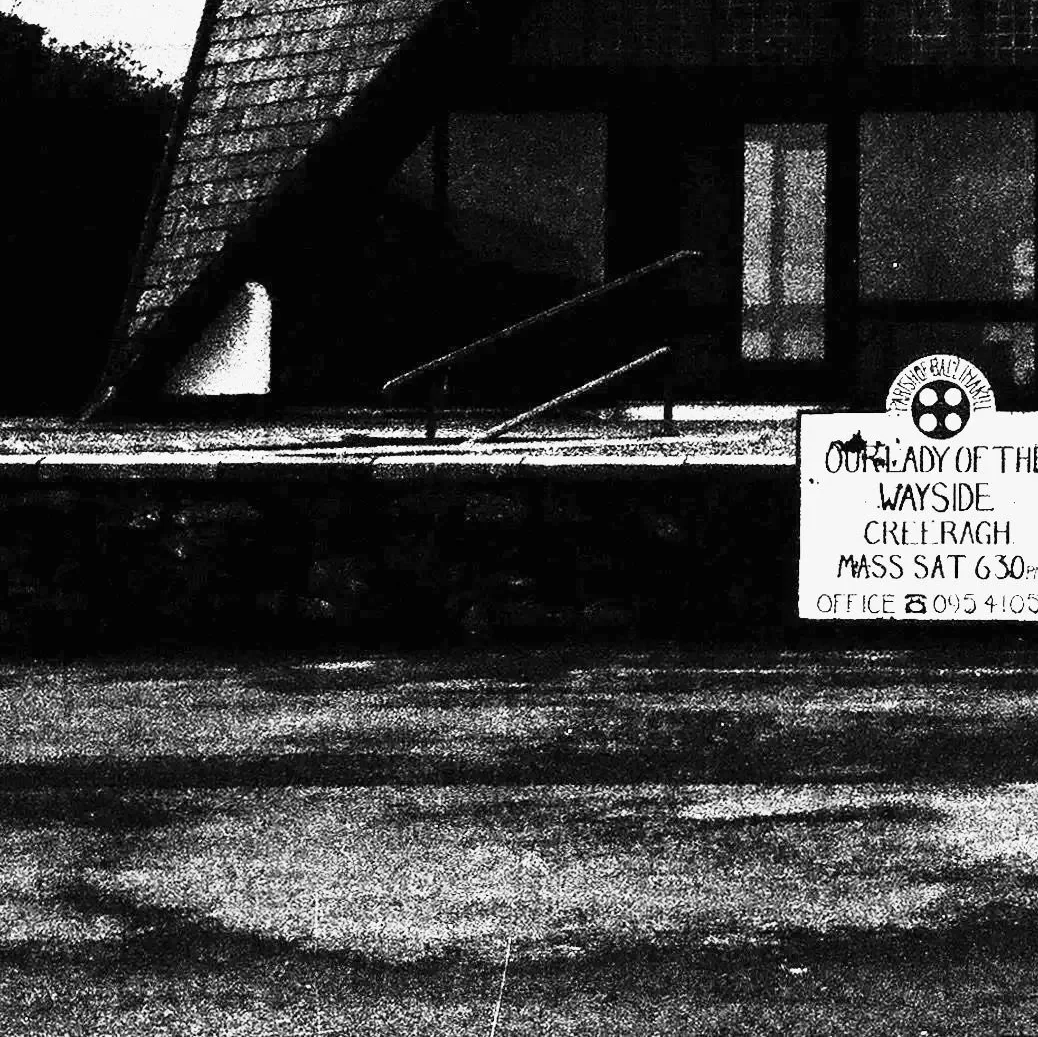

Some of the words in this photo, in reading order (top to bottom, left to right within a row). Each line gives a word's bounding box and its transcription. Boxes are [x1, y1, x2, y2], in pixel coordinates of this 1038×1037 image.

[825, 440, 880, 473] OUR
[886, 445, 949, 473] LADY
[955, 445, 989, 473] OF
[879, 482, 994, 512] WAYSIDE
[864, 520, 1010, 545] CREERAGH
[837, 554, 904, 579] MASS
[914, 554, 967, 579] SAT
[817, 594, 895, 614] OFFICE
